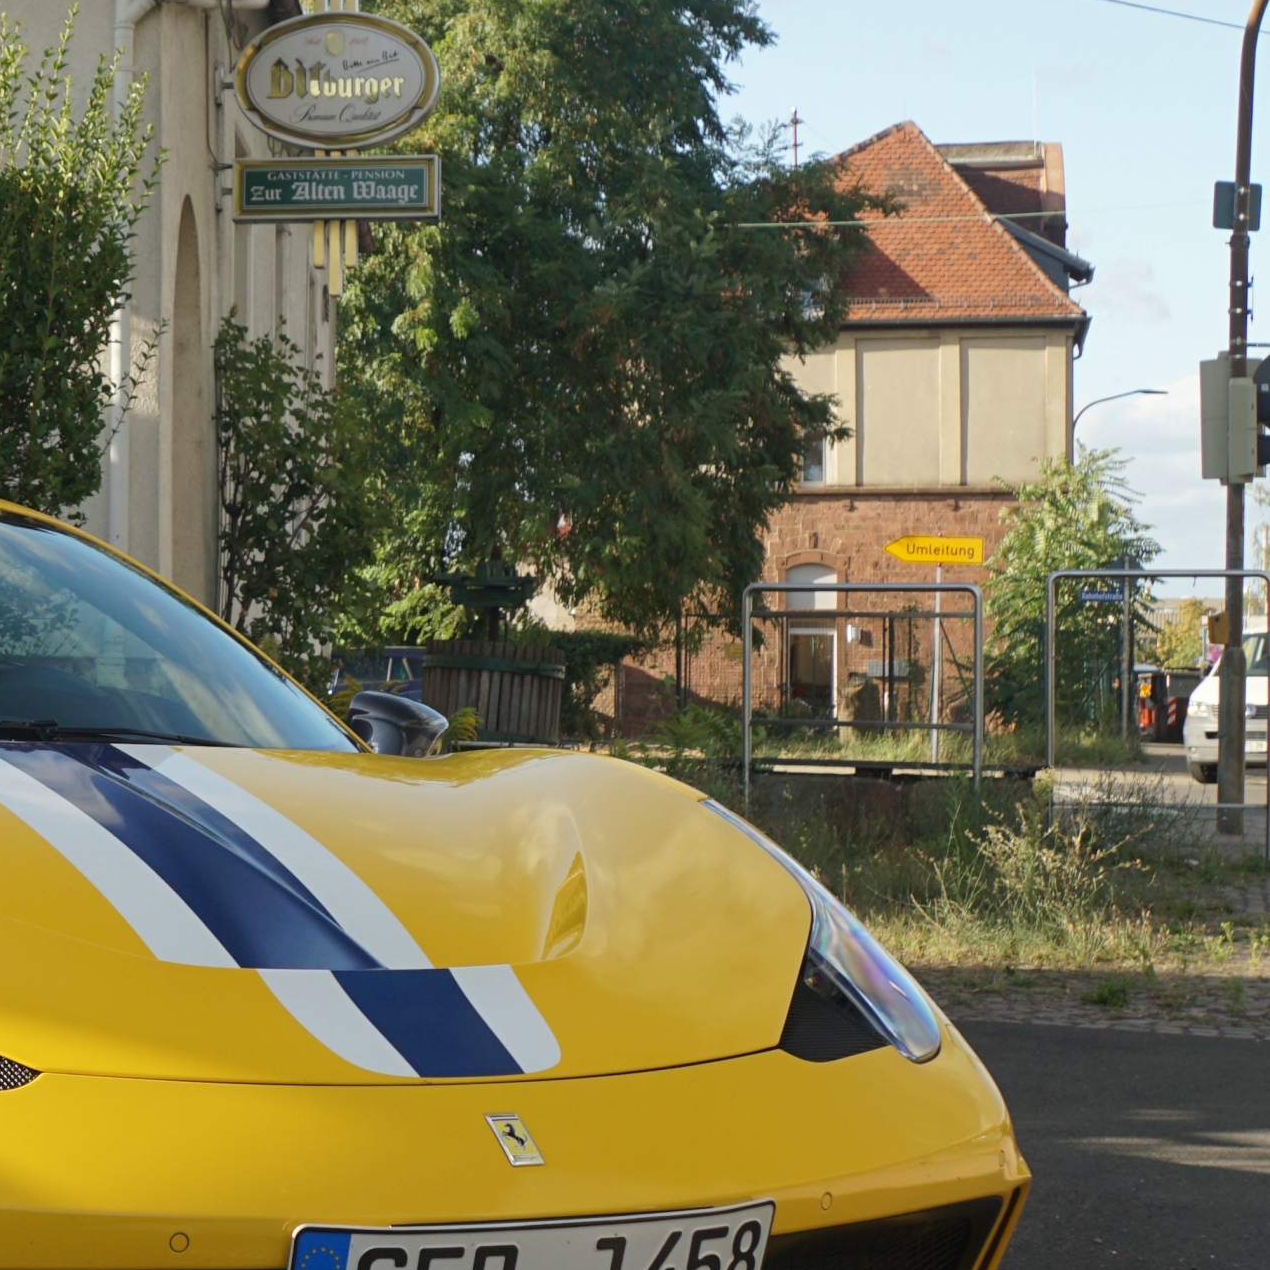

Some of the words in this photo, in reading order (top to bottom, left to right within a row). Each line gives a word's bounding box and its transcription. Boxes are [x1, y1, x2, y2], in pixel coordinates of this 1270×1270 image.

[267, 56, 405, 105] Bitburger
[267, 170, 340, 181] GASTSTÄTTE
[351, 169, 405, 180] PENSION
[250, 185, 283, 201] Zur
[291, 181, 345, 201] Alten
[352, 180, 419, 205] Waage
[906, 542, 975, 559] Umleitung
